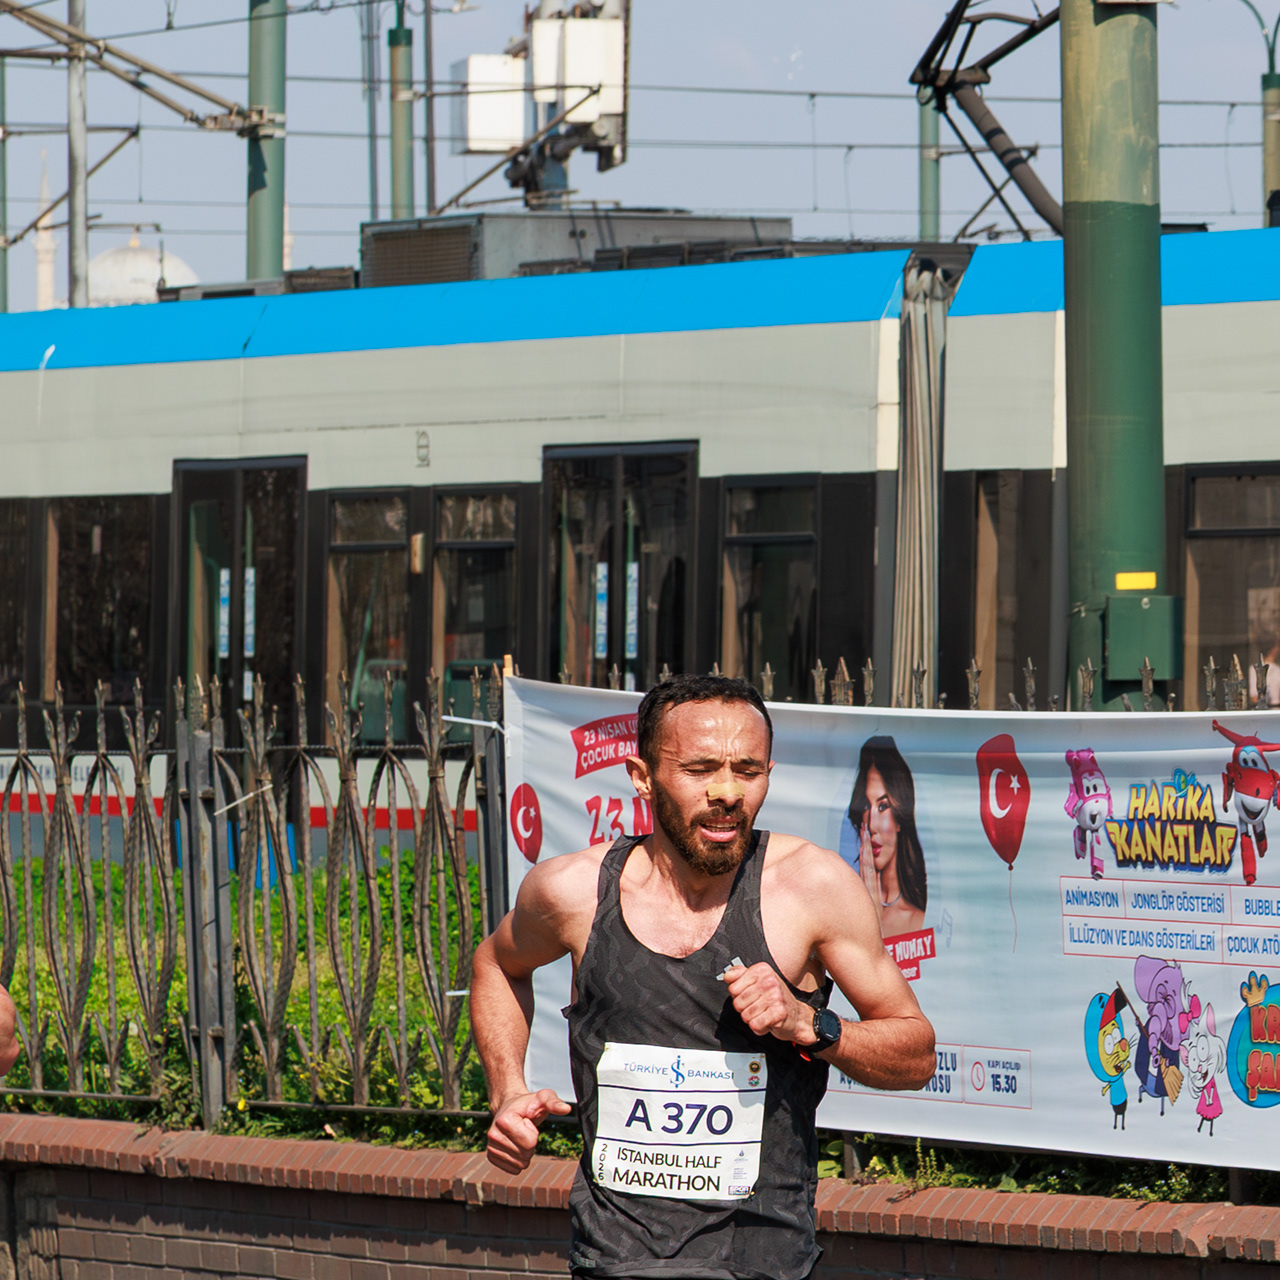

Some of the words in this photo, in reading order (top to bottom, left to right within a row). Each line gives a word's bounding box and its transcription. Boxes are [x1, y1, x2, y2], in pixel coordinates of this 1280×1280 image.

[583, 729, 596, 747] 23
[598, 721, 628, 740] NİSAN
[581, 743, 615, 770] ÇOCUK
[585, 795, 625, 847] 23
[1105, 820, 1238, 866] KANATLAR
[1065, 886, 1119, 908] ANİMASYON
[1131, 890, 1175, 911] JONGLÖR
[1177, 891, 1225, 913] GÖSTERİSİ
[1069, 922, 1114, 944] İLLÜZYON
[1115, 929, 1127, 946] VE
[1129, 930, 1154, 947] DANS
[1156, 928, 1215, 951] GÖSTERİLERİ
[1227, 936, 1260, 956] ÇOCUK
[624, 1062, 668, 1076] TÜRKİYE
[687, 1069, 734, 1081] BANKASI
[991, 1073, 1018, 1095] 15.30
[625, 1099, 653, 1132] A
[661, 1102, 733, 1135] 370
[617, 1147, 682, 1168] ISTANBUL
[685, 1156, 722, 1169] HALF
[612, 1167, 721, 1192] MARATHON
